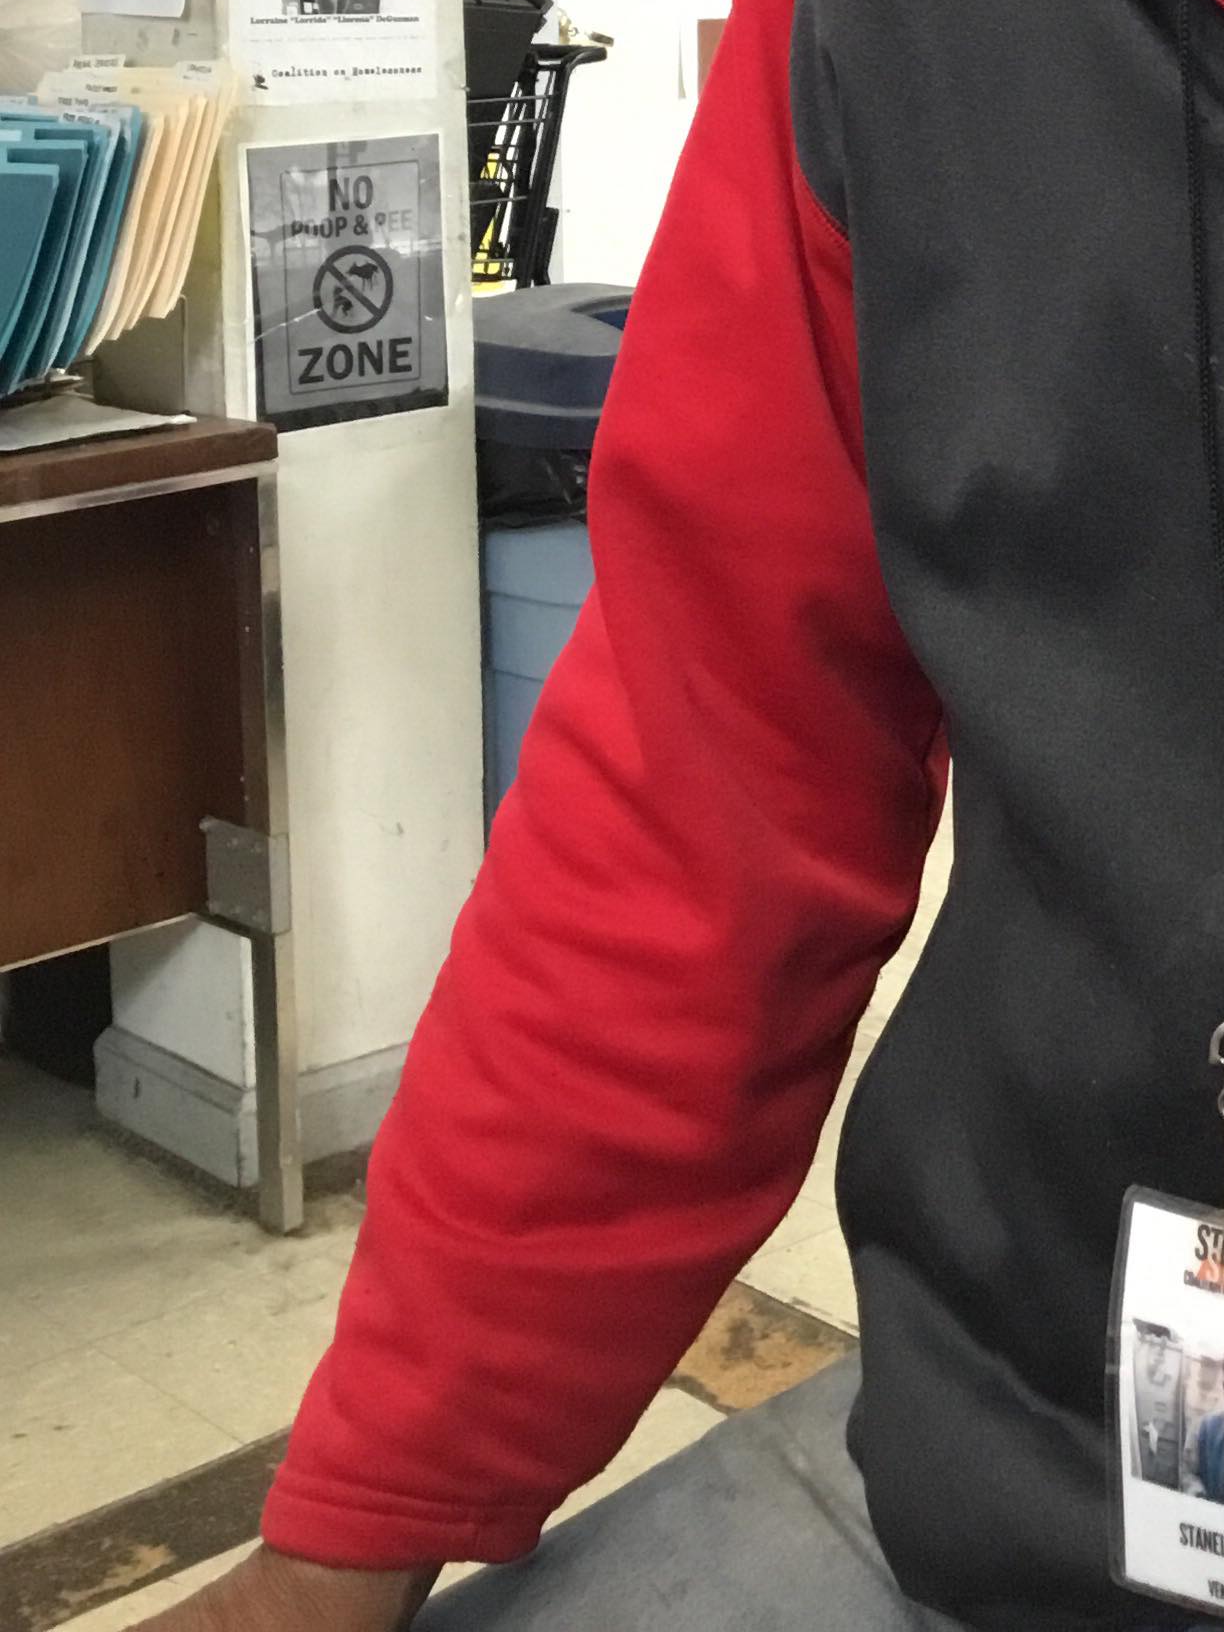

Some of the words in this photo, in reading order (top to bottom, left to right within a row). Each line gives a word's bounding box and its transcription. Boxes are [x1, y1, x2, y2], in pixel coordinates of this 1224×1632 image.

[250, 16, 288, 24] Lorraine
[272, 66, 328, 78] Coalition
[334, 69, 346, 77] on
[352, 66, 422, 77] Homelessness
[329, 175, 373, 212] NO
[291, 214, 347, 239] POOP
[353, 214, 369, 236] &
[375, 209, 413, 233] PEE
[298, 337, 413, 385] ZONE
